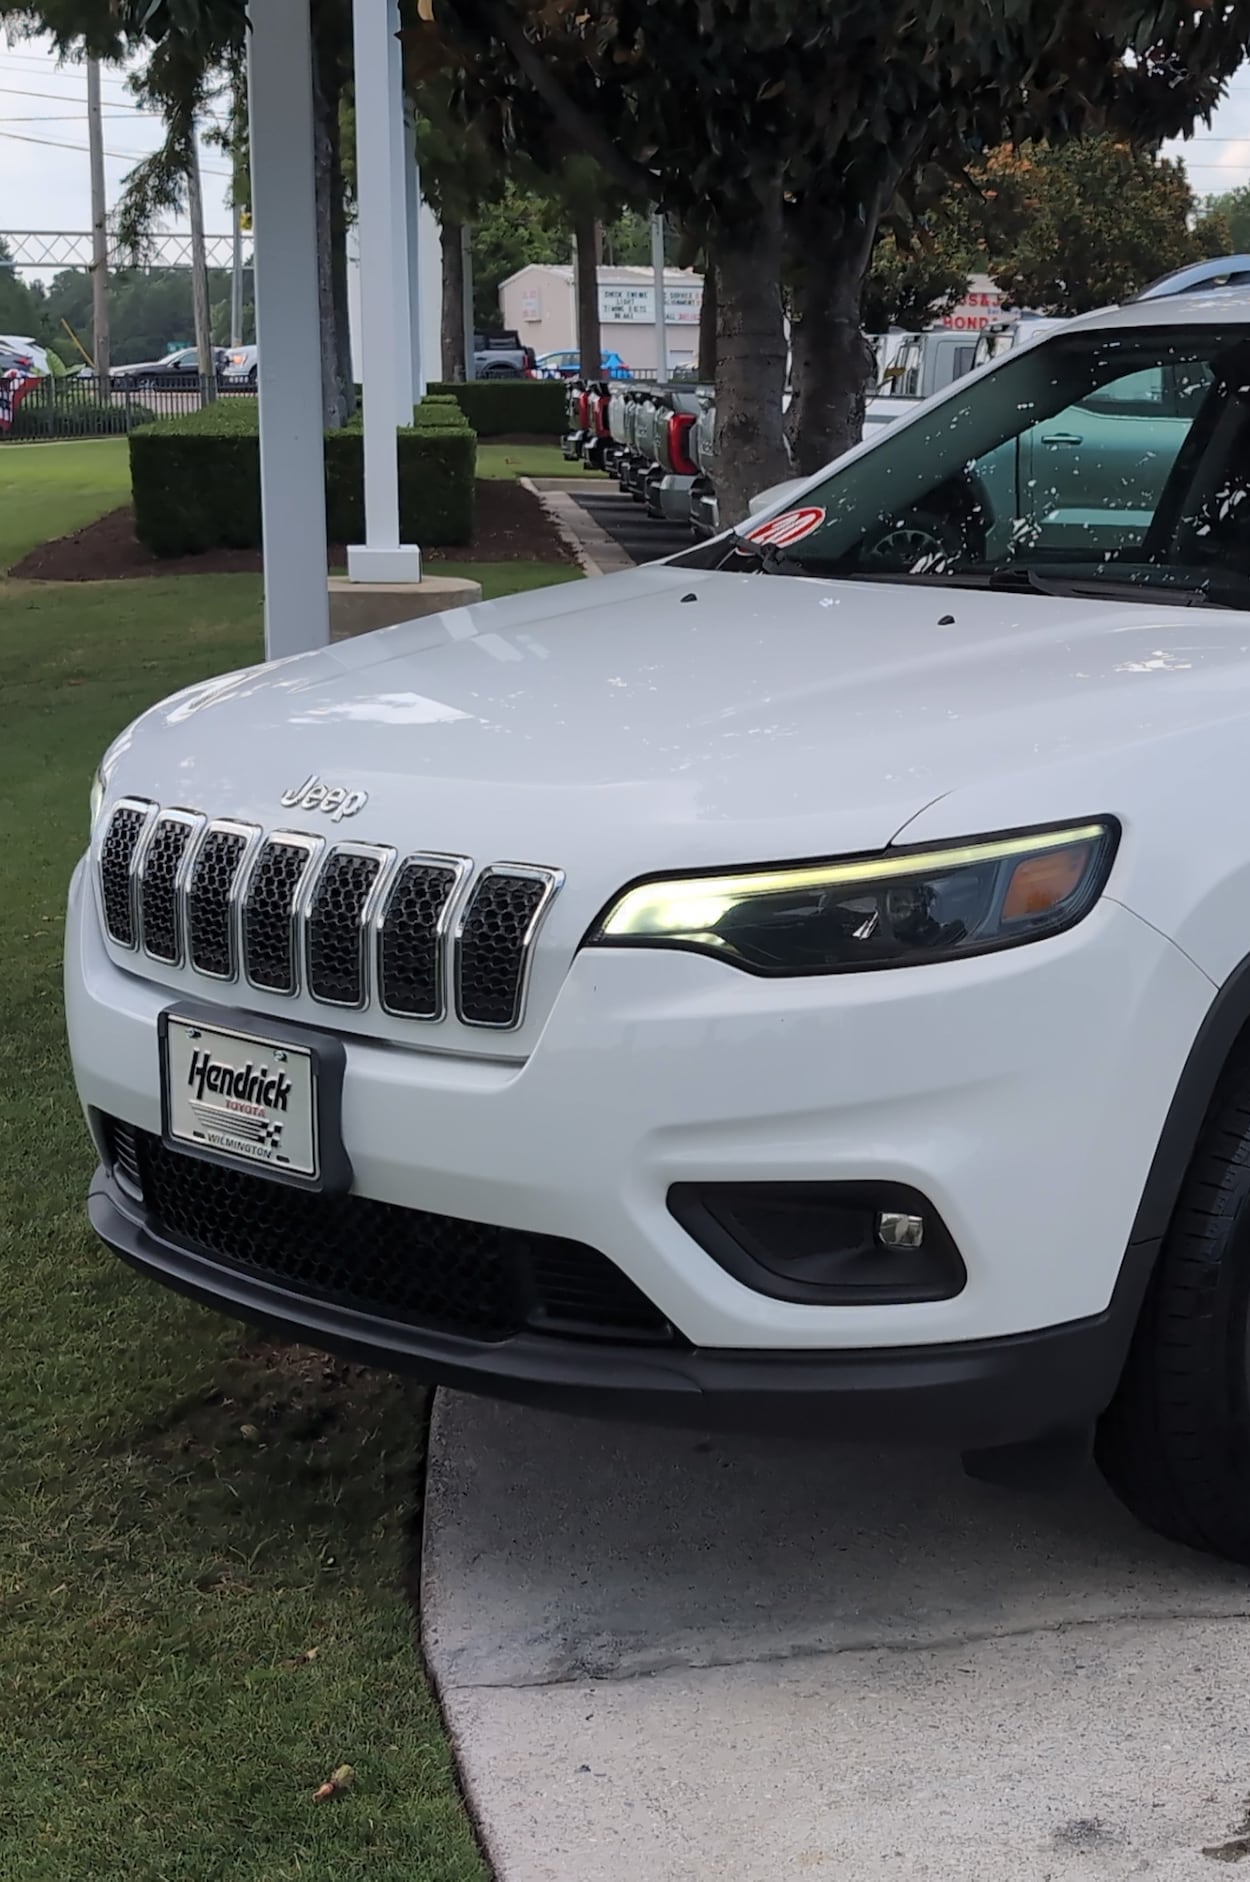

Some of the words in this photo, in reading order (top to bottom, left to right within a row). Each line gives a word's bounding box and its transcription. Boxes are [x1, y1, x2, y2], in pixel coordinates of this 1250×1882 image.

[280, 774, 368, 823] Jeep
[188, 1048, 292, 1112] Hendrick
[225, 1099, 266, 1118] TOYOTA
[207, 1132, 272, 1159] WILMINGTON
